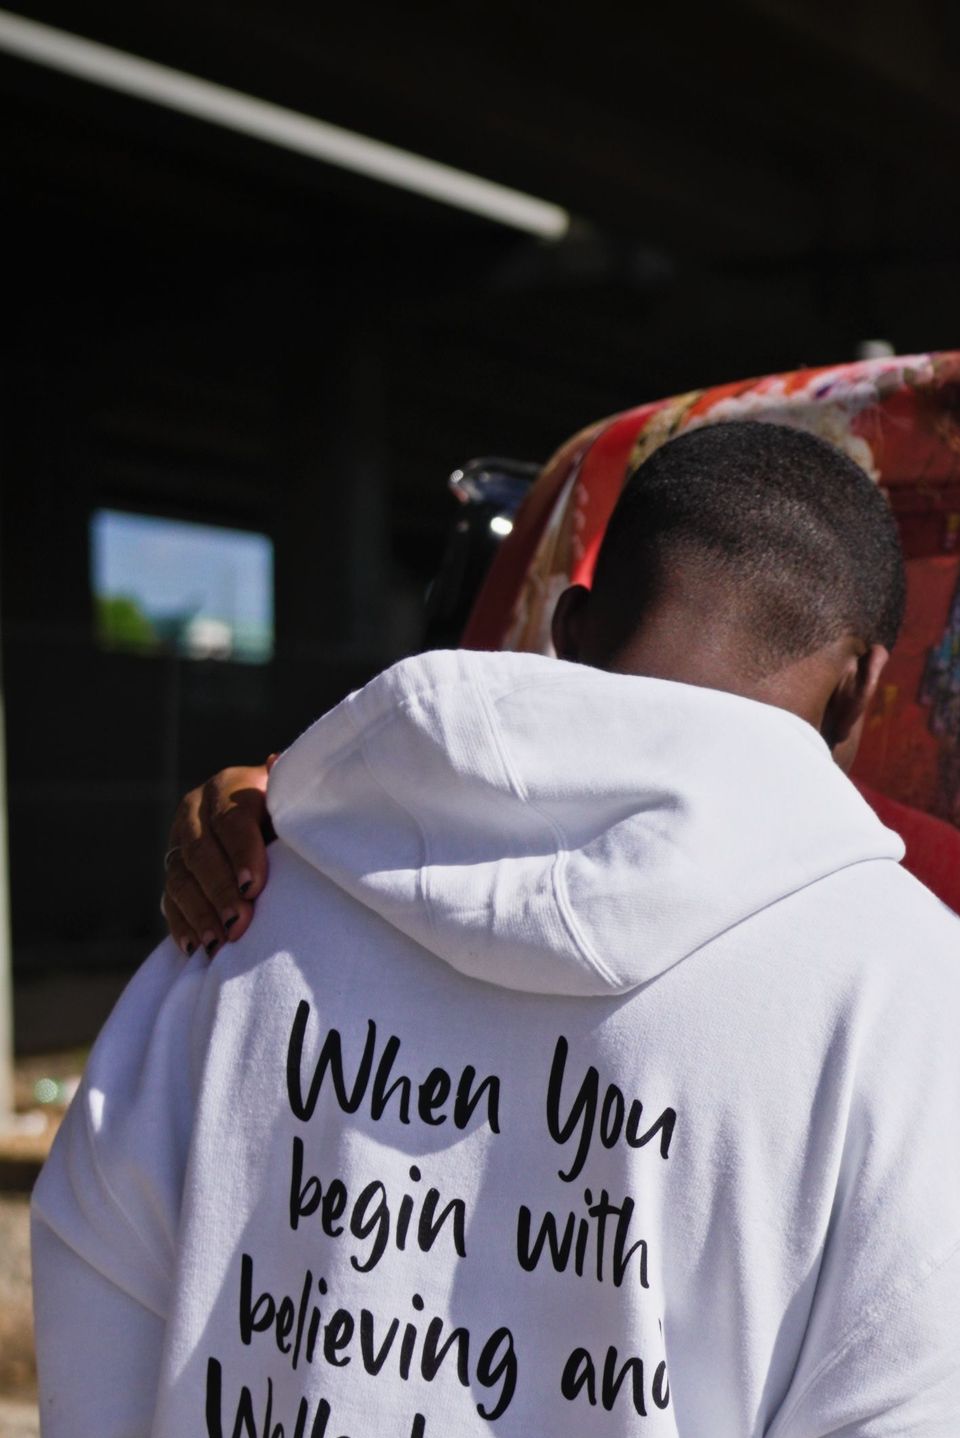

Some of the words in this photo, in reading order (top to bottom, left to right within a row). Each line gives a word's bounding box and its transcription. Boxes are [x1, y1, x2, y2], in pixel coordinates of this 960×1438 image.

[286, 1000, 500, 1134] When
[546, 1035, 677, 1182] You
[289, 1136, 467, 1273] begin
[516, 1188, 650, 1289] with
[240, 1253, 518, 1422] believing
